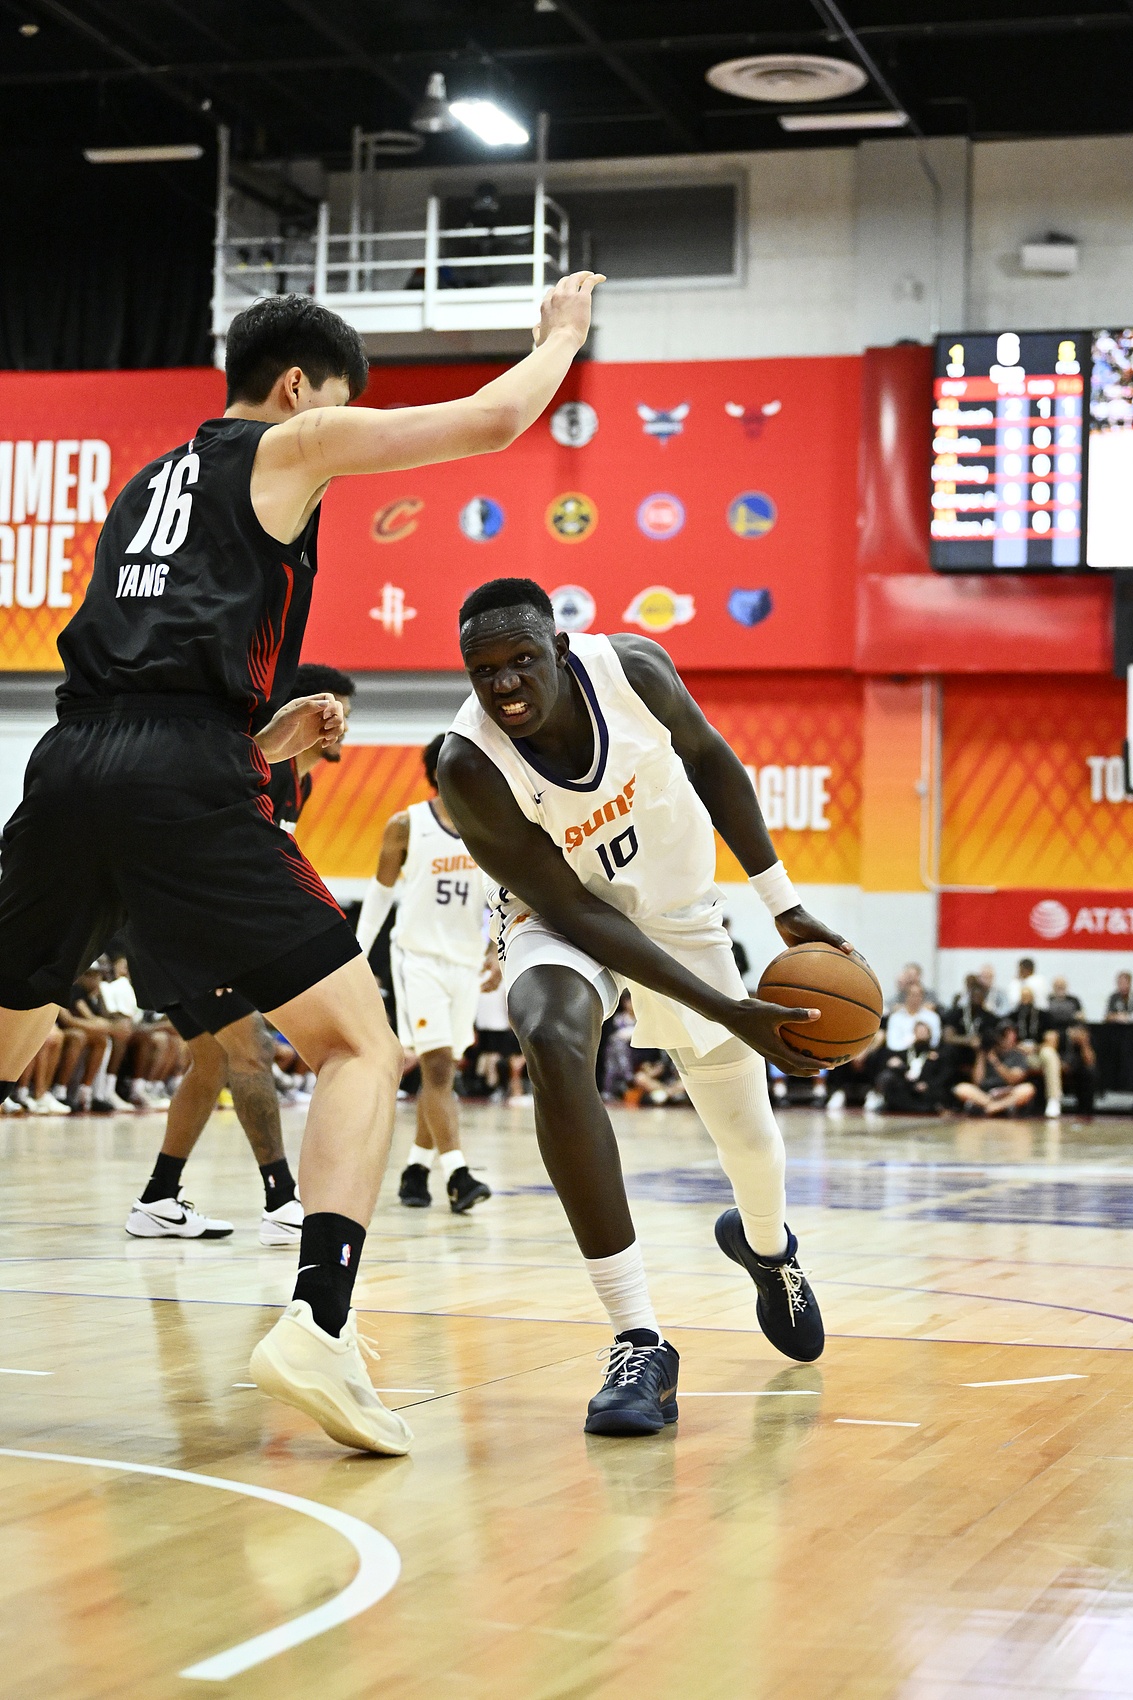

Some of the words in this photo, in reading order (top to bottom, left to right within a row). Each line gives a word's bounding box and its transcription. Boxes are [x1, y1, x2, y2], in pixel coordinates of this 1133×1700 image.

[125, 453, 200, 557] 16
[115, 563, 170, 599] YANG
[1085, 755, 1133, 803] TO
[595, 824, 639, 882] 10
[436, 879, 469, 906] 54
